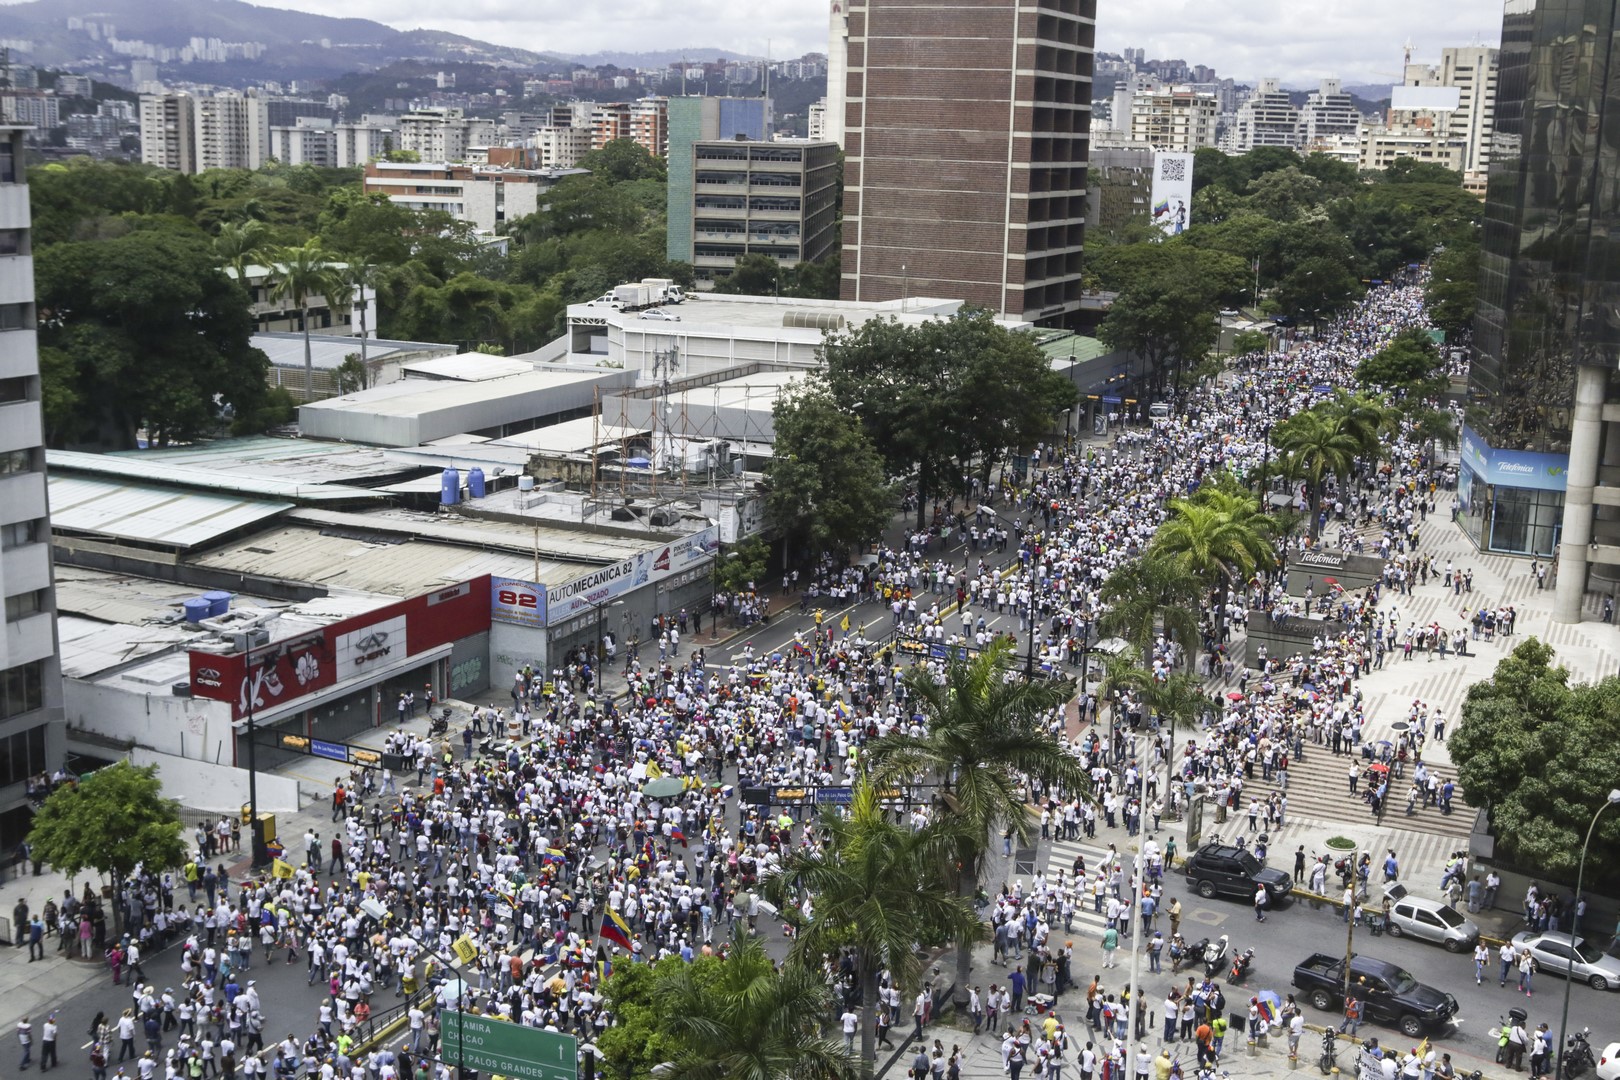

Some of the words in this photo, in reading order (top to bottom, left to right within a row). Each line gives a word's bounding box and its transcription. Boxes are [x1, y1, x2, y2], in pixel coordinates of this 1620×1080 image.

[492, 580, 544, 598] AUTOMECANICA
[549, 566, 621, 604] AUTOMECANICA
[622, 561, 633, 575] 82
[498, 590, 538, 609] 82
[355, 646, 391, 666] CHERY
[196, 677, 222, 688] CHERY
[448, 1017, 491, 1034] ALAMIRA
[468, 1055, 498, 1069] PALOS
[500, 1062, 543, 1078] GRANDES
